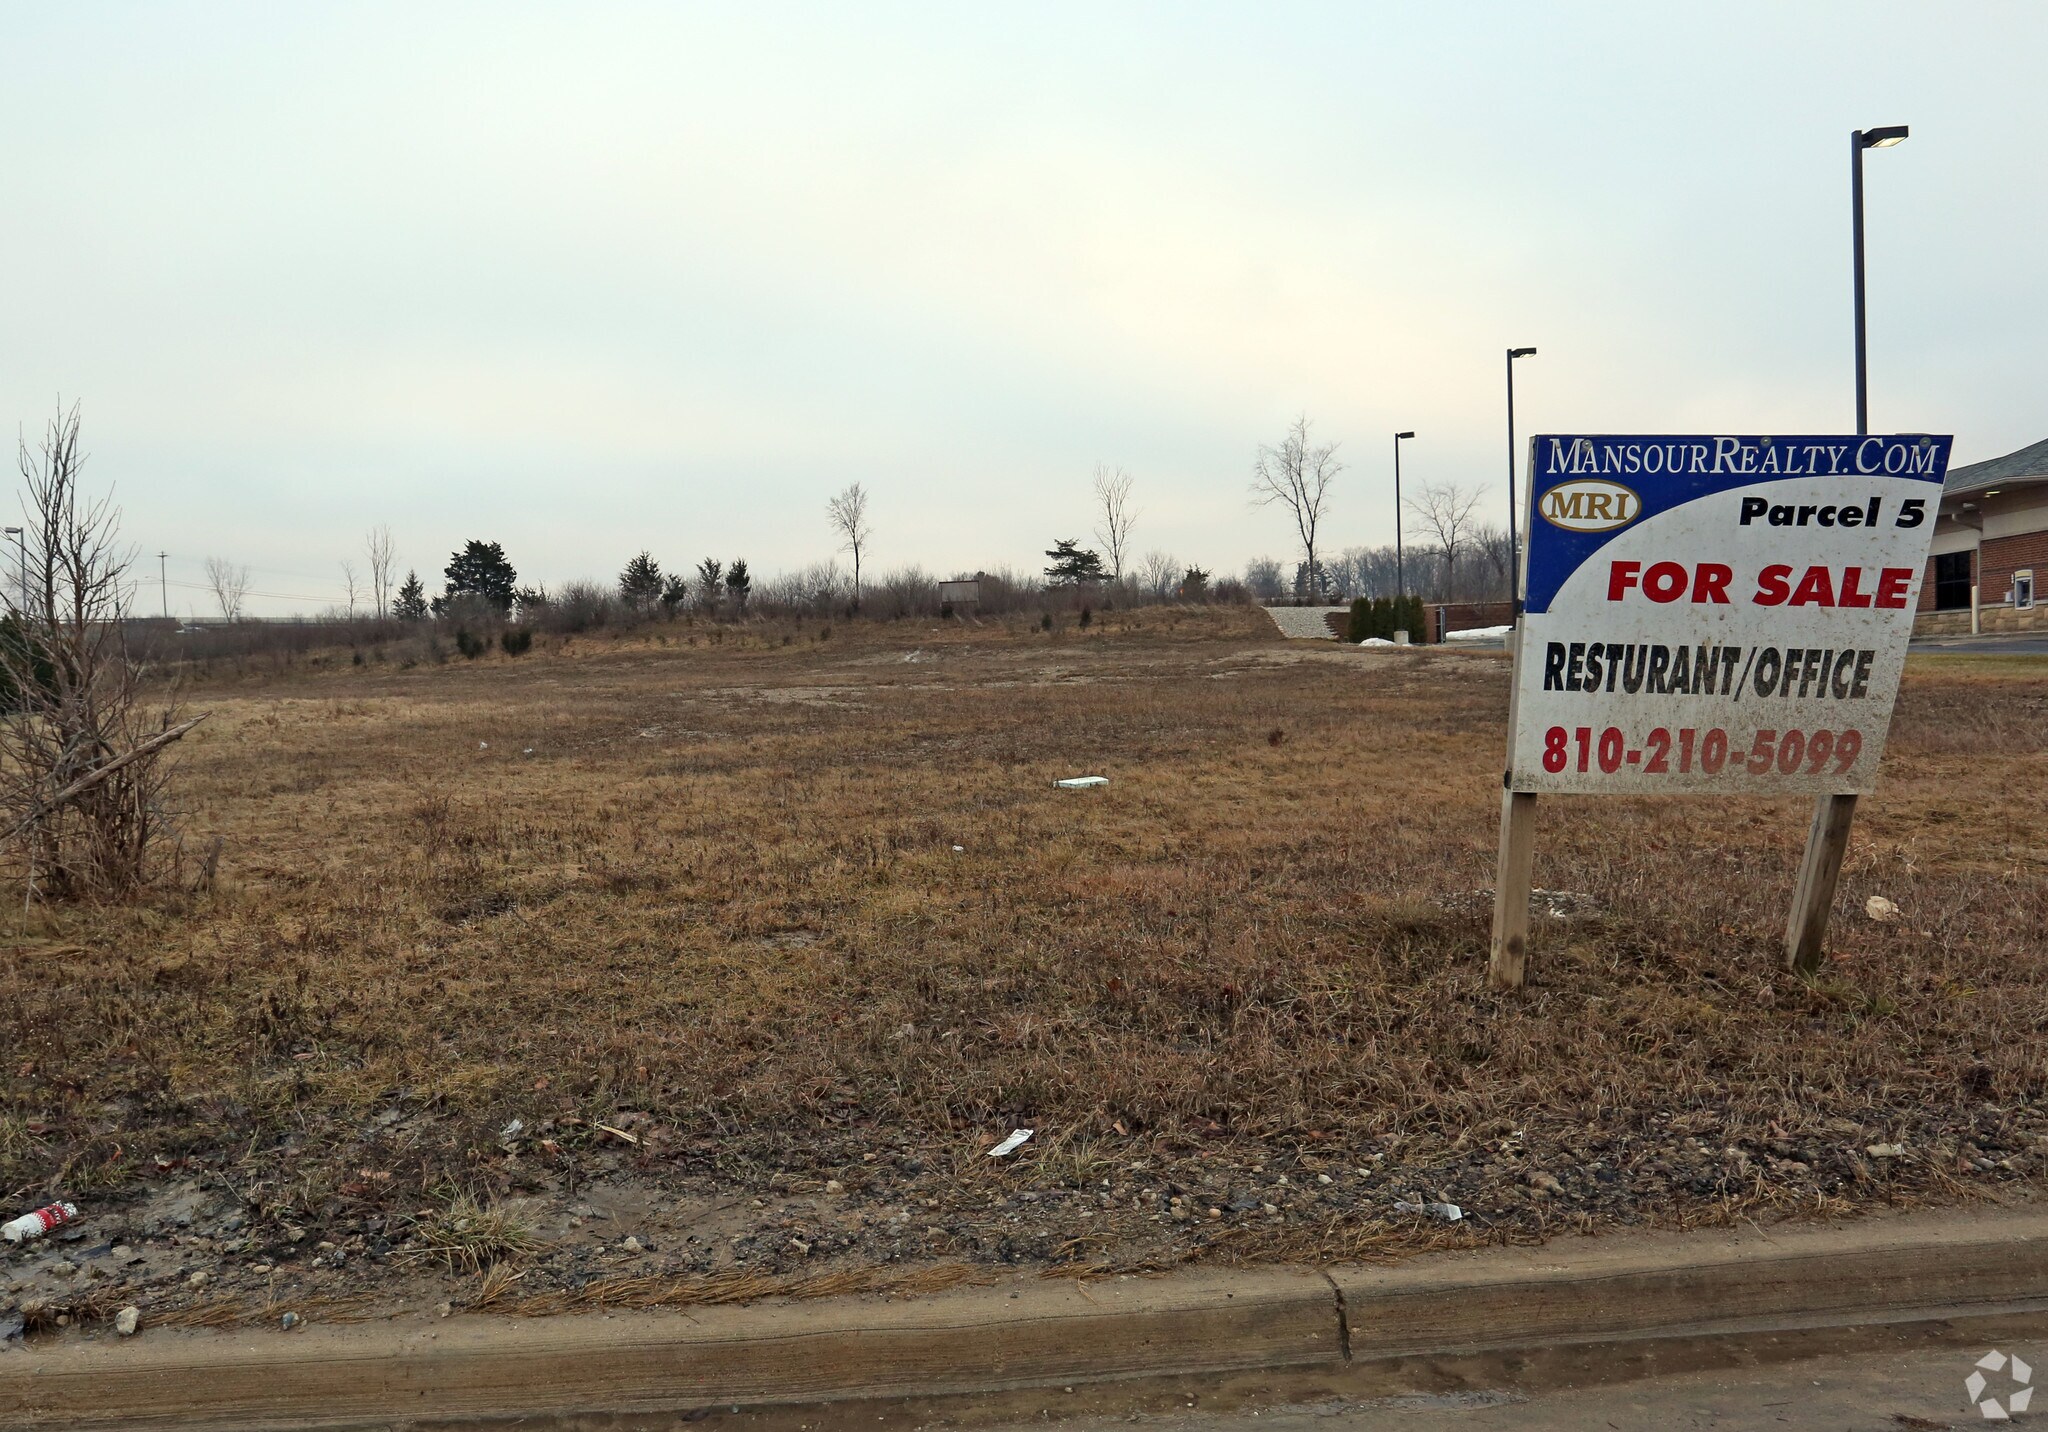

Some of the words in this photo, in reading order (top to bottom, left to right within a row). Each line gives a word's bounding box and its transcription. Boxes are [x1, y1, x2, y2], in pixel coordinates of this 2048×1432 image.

[1548, 491, 1630, 521] MRI
[1739, 496, 1881, 528] Parcel
[1895, 499, 1925, 528] 5
[1607, 560, 1733, 604] FOR
[1751, 564, 1914, 609] SALE
[1543, 641, 1875, 702] RESTURANT/OFFICE
[1542, 726, 1863, 776] 810-210-5099
